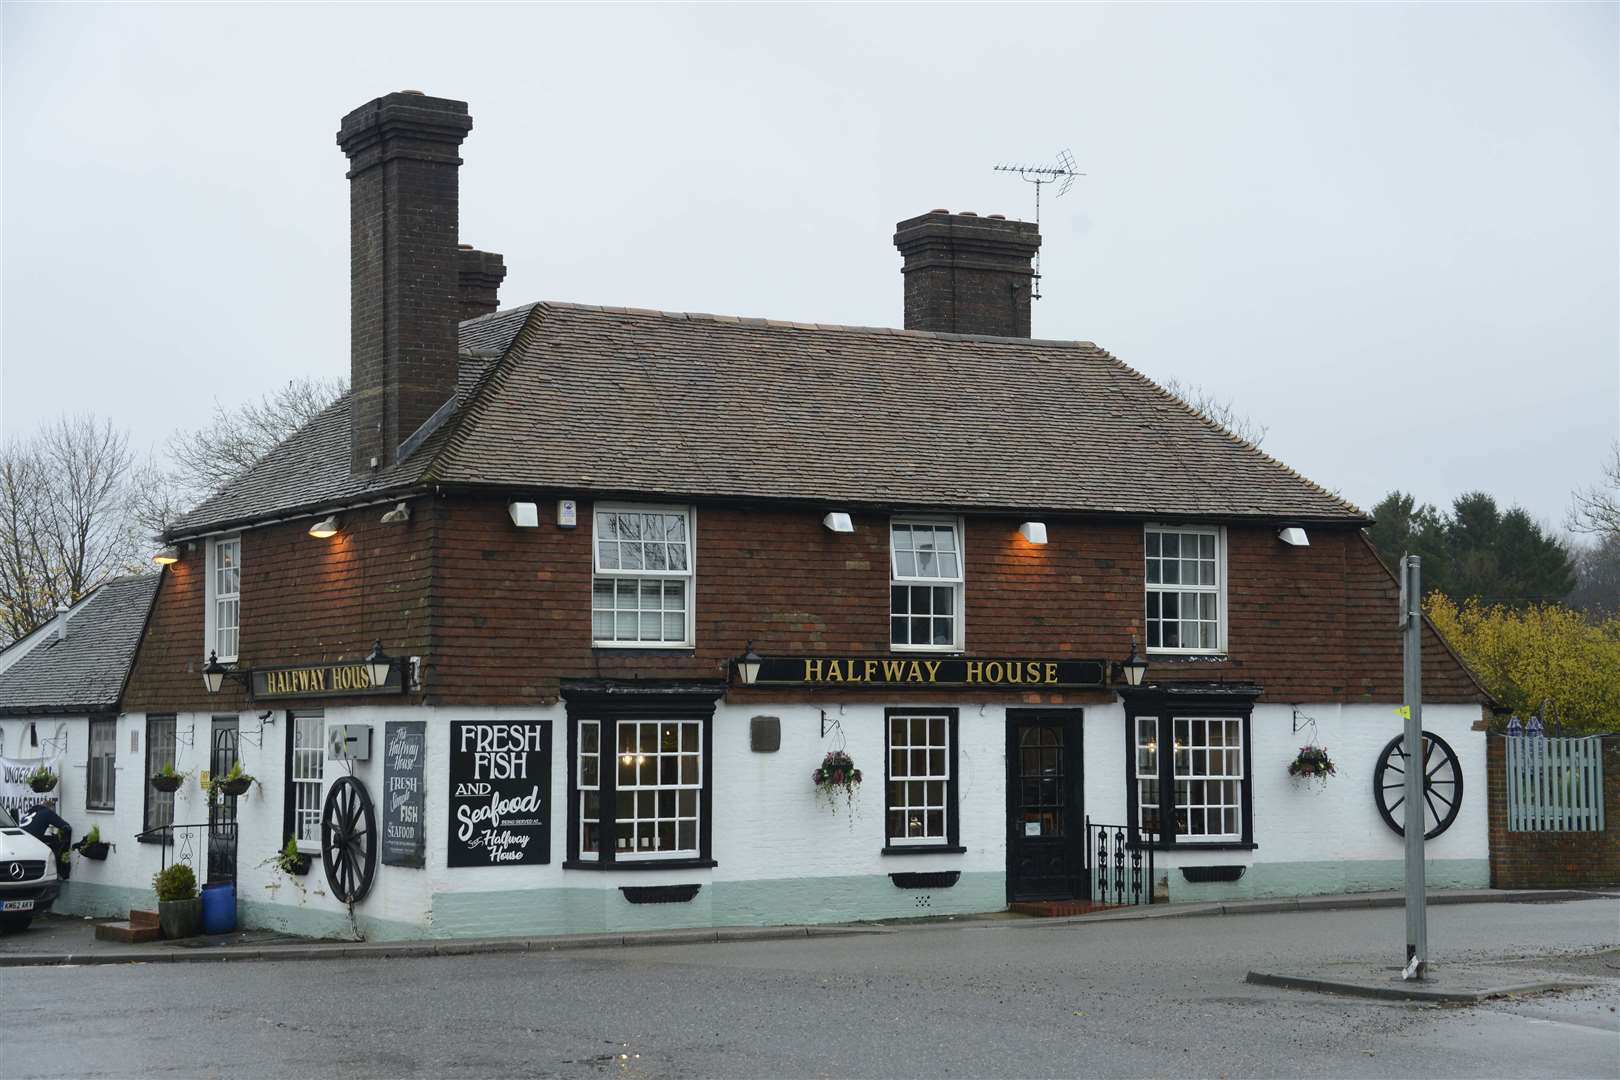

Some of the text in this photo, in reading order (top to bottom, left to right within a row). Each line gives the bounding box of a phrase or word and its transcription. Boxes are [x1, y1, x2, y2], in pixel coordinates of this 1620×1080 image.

[267, 665, 370, 694] HALFWAY HOUS
[804, 659, 1058, 684] HALFWAY HOUSE
[460, 725, 542, 752] FRESH
[474, 752, 528, 779] FISH
[390, 777, 417, 792] FRESH
[455, 783, 492, 796] AND
[400, 805, 418, 823] FISH
[457, 785, 542, 842] Seafood
[387, 822, 415, 839] SEAFOOD
[481, 829, 530, 849] Halfway
[487, 845, 524, 862] House
